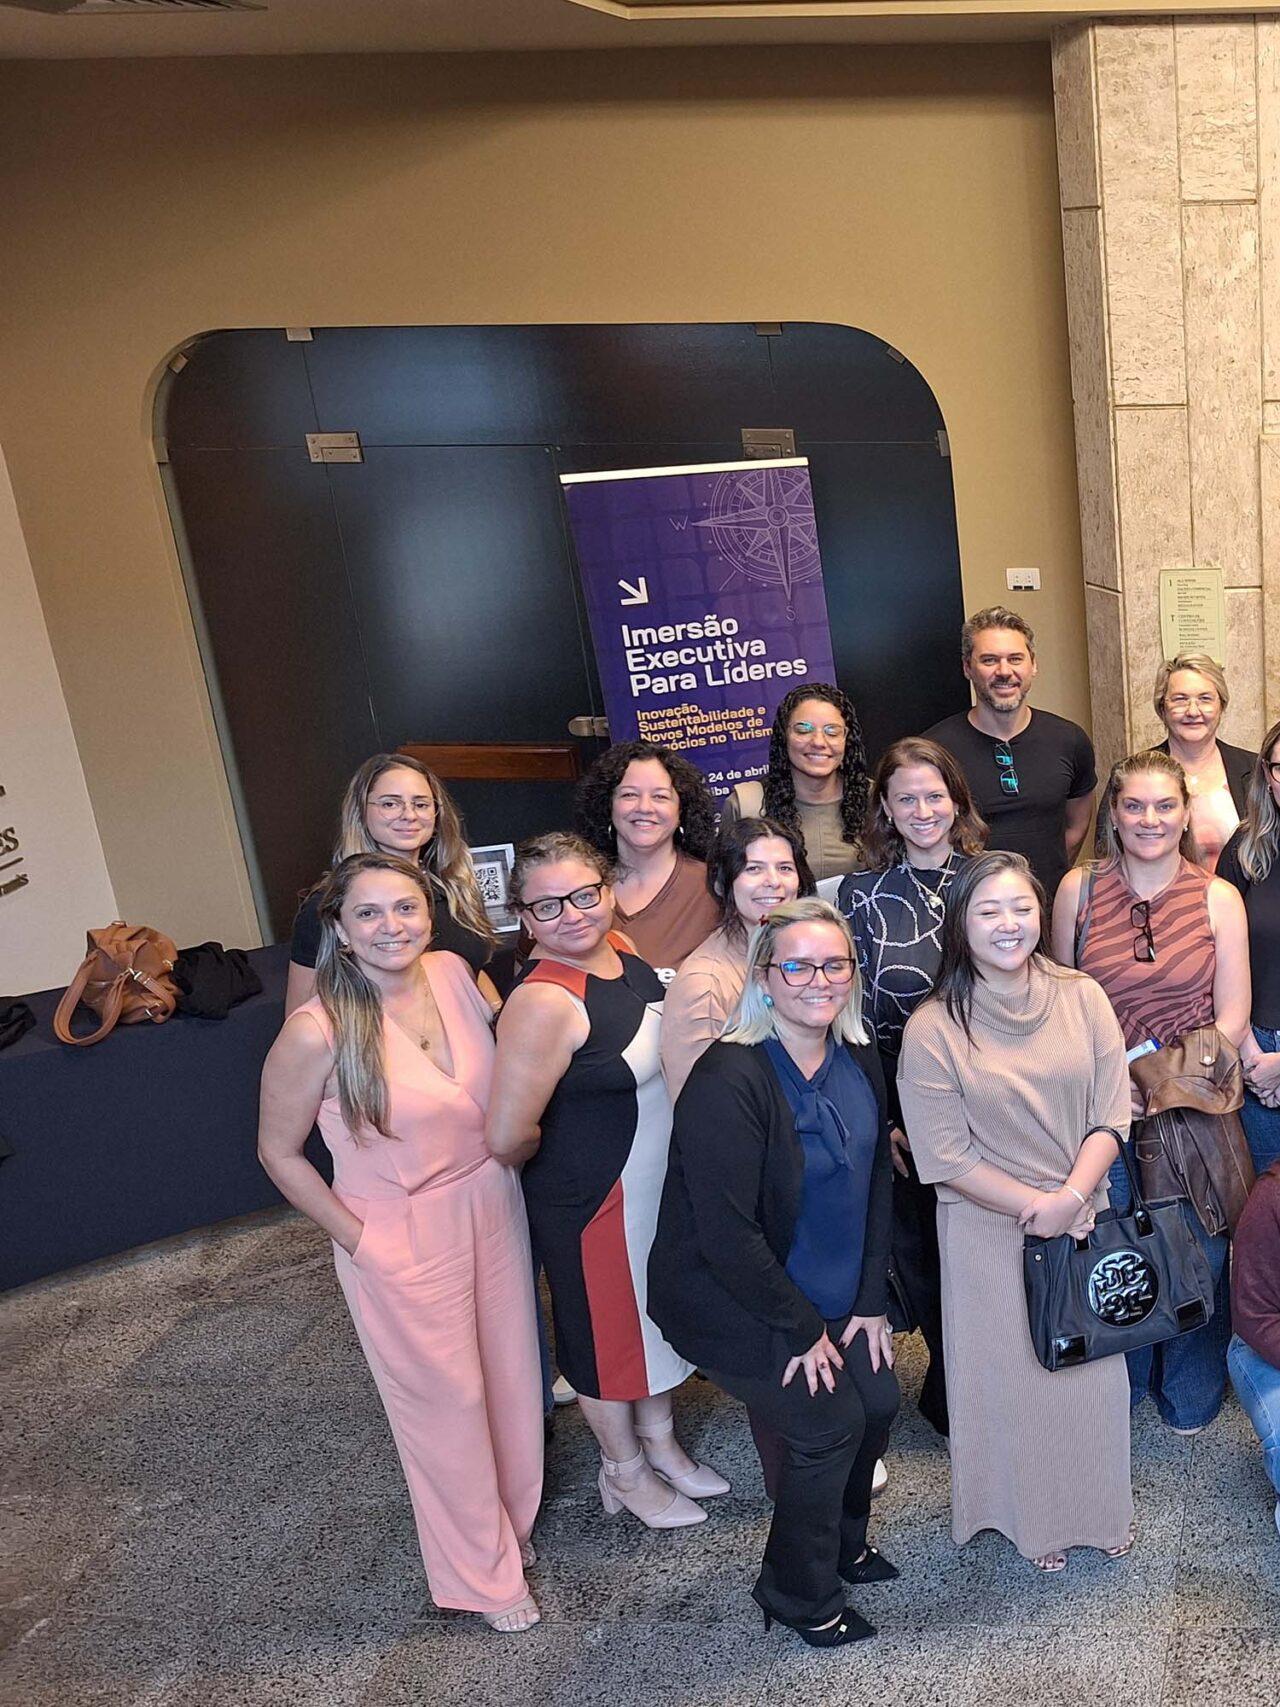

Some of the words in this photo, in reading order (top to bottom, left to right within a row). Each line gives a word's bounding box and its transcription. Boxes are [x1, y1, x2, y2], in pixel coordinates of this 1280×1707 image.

[621, 614, 738, 648] Imersão
[625, 637, 766, 673] Executiva
[629, 671, 697, 697] Para
[704, 657, 808, 687] Líderes
[637, 703, 702, 721] Inovação,
[638, 706, 754, 733] Sustentabilidade
[757, 706, 766, 715] e
[640, 729, 684, 743] Novos
[686, 719, 744, 737] Modelos
[746, 717, 764, 728] de
[710, 734, 727, 745] no
[729, 727, 773, 741] Turism
[708, 771, 724, 783] 24
[726, 769, 742, 780] de
[744, 764, 770, 777] abril
